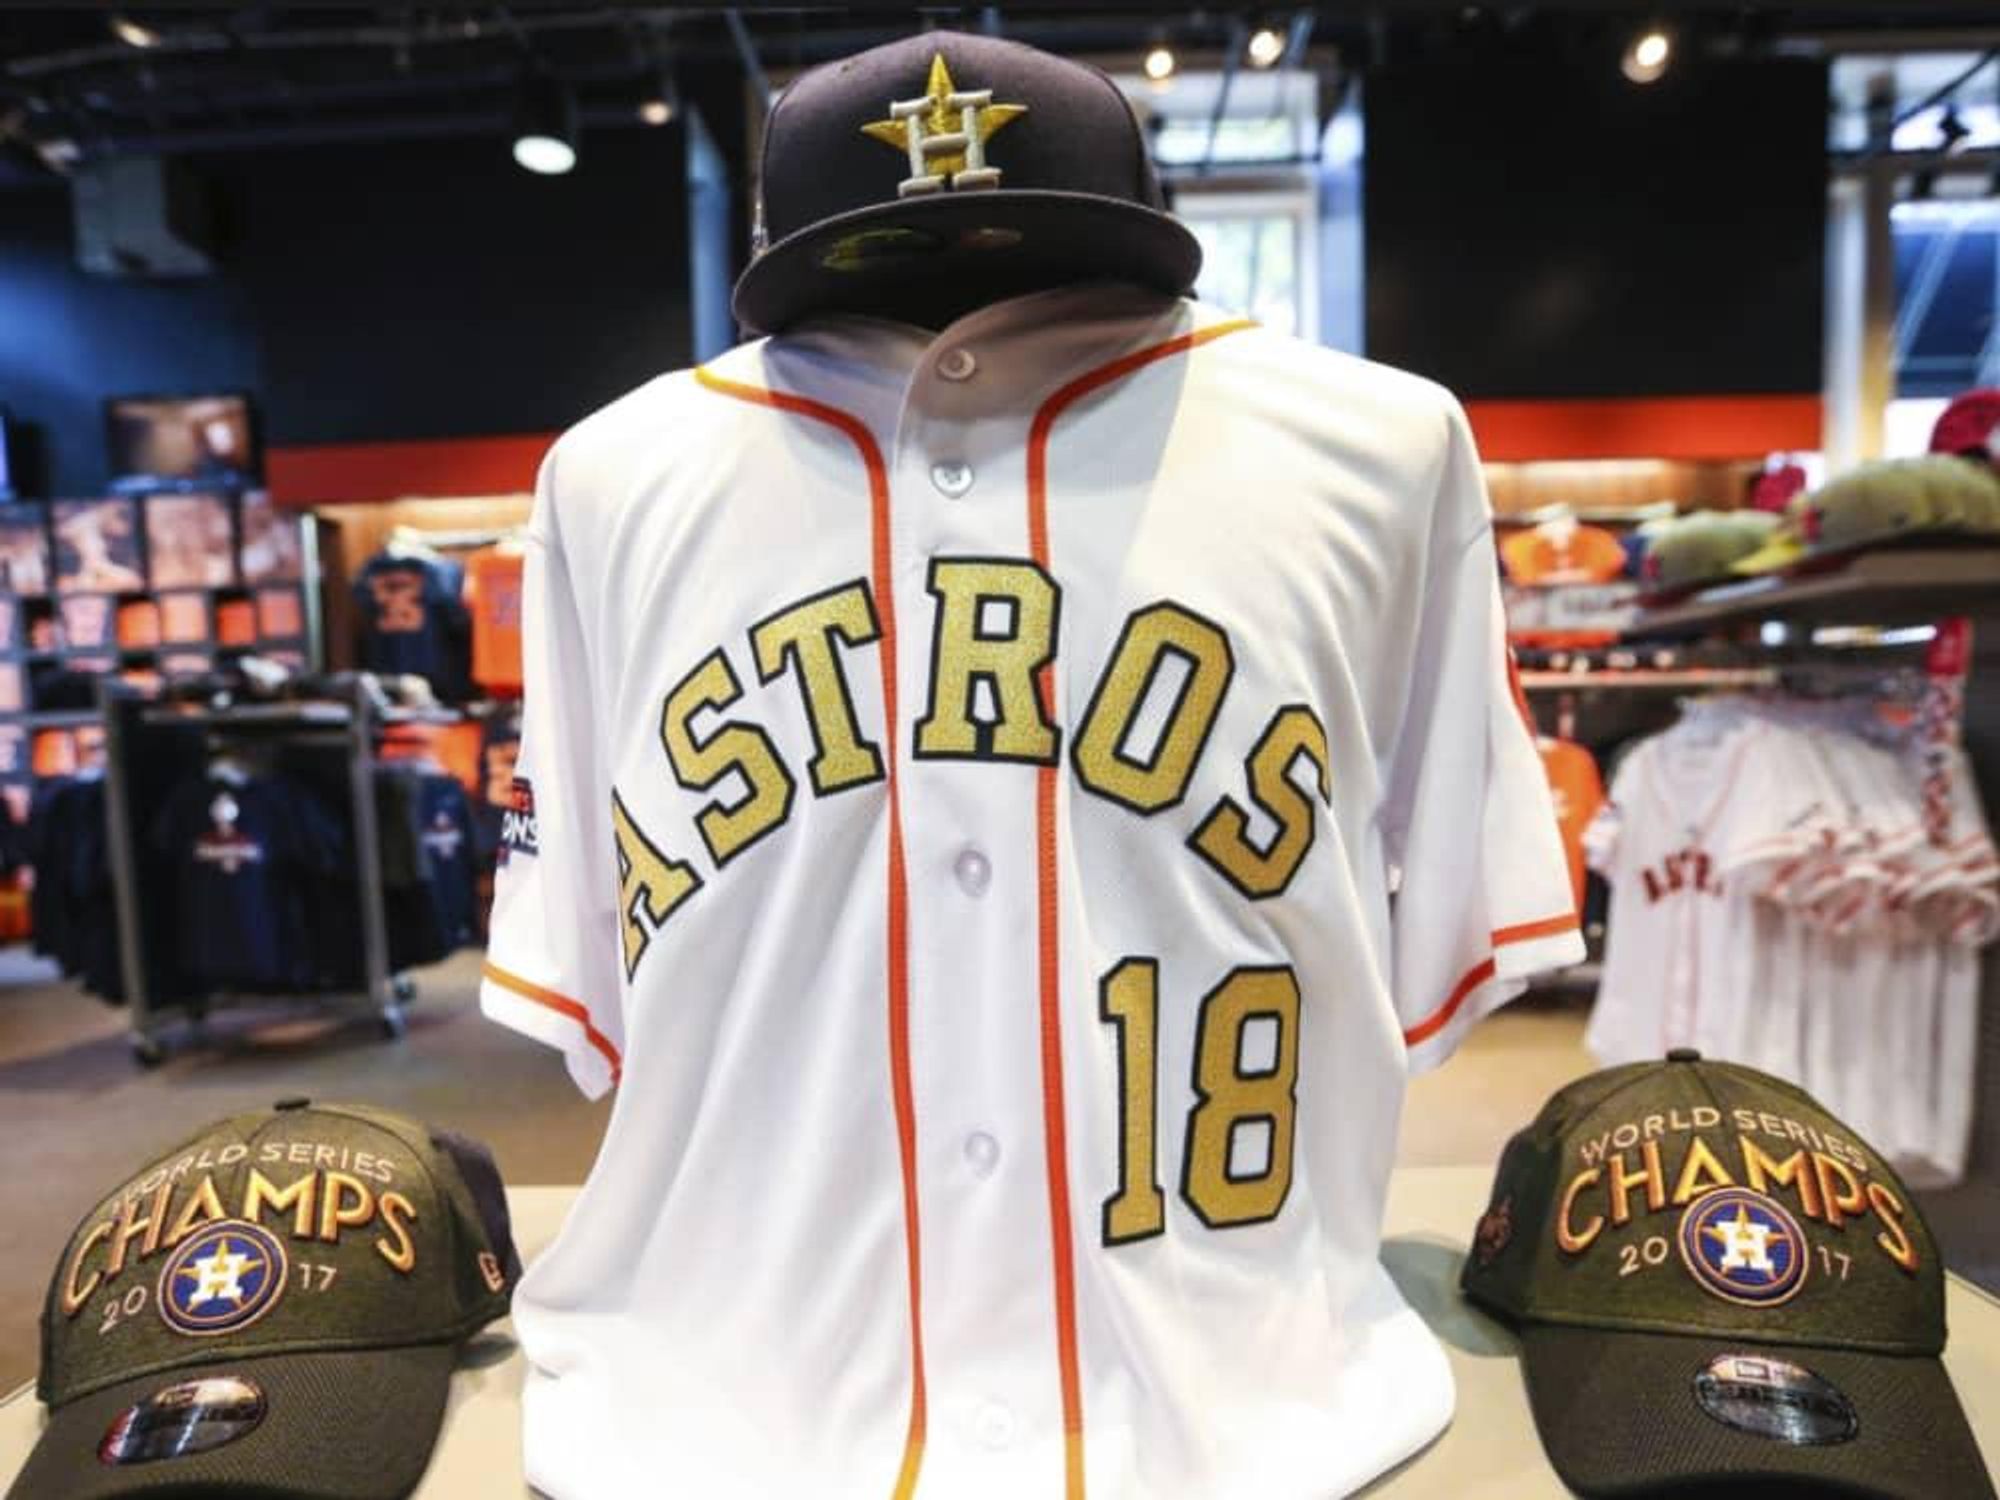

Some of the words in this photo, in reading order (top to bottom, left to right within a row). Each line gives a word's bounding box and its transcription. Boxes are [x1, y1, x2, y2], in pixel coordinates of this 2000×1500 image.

[890, 89, 1003, 197] H
[610, 556, 1332, 984] ASTROS
[1098, 955, 1301, 1247] 18
[258, 1143, 397, 1183] SERIES
[1580, 1106, 1722, 1166] WORLD
[1733, 1109, 1868, 1171] SERIES
[1556, 1134, 1922, 1271] CHAMPS
[61, 1166, 418, 1318] CHAMPS
[188, 1253, 248, 1302] H
[1618, 1236, 1669, 1277] 20
[1816, 1245, 1852, 1281] 17
[1716, 1221, 1776, 1270] H
[98, 1285, 148, 1335] 20
[297, 1262, 338, 1292] 17
